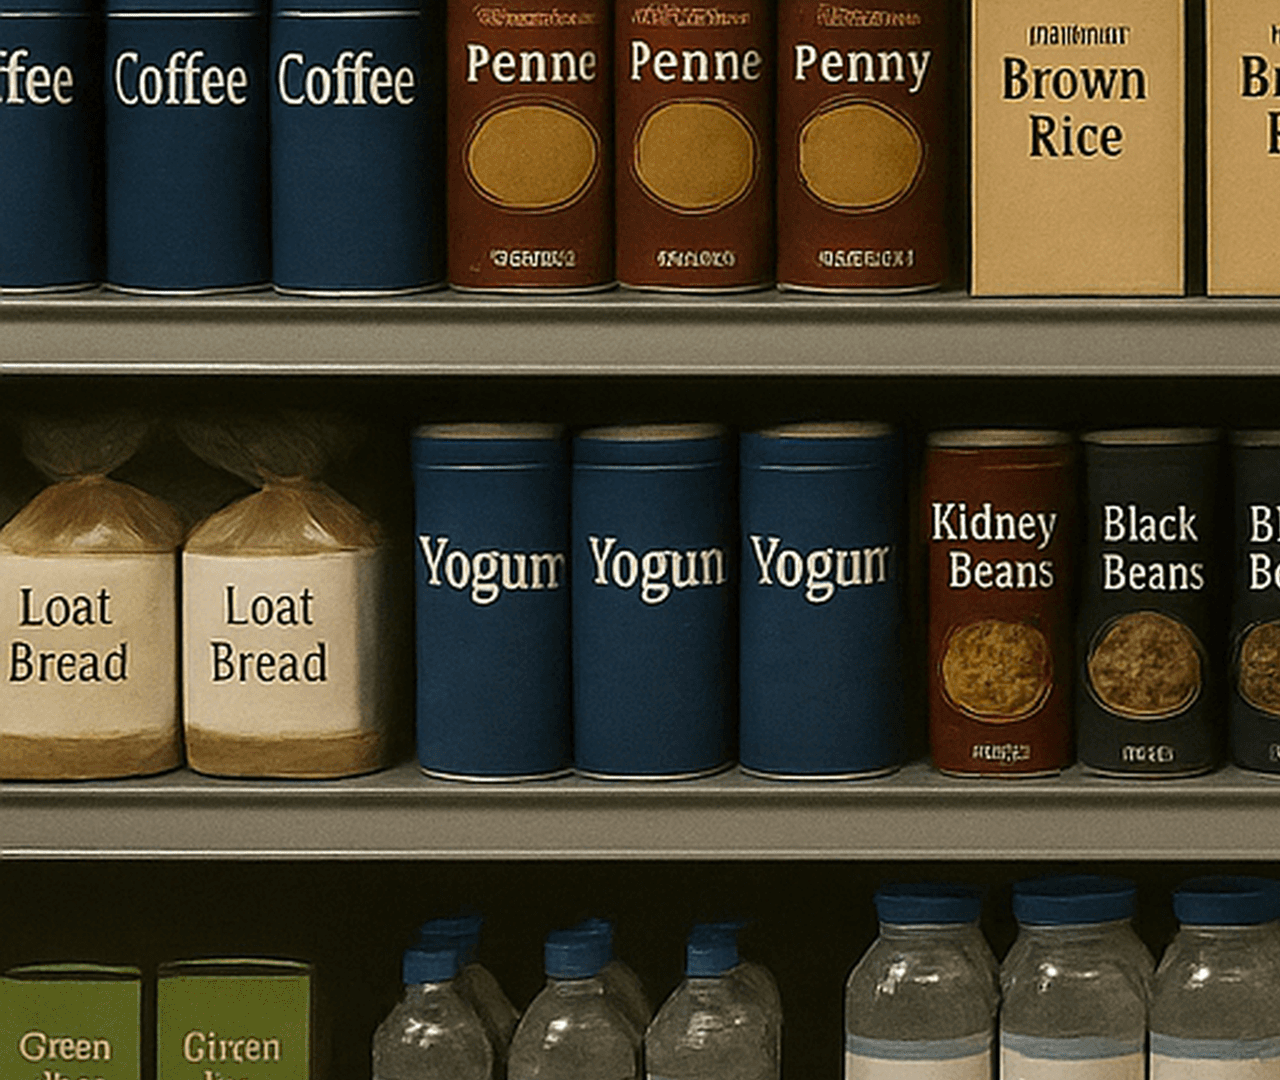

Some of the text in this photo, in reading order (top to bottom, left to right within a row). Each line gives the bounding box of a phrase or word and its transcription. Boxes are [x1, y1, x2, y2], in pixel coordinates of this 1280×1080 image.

[115, 50, 248, 106] Coffee
[278, 50, 415, 106] Coffee
[467, 43, 596, 83] Penne
[631, 40, 763, 82] Penne
[794, 44, 931, 93] Penny
[1003, 56, 1147, 100] Brown
[1029, 114, 1124, 157] Rice
[932, 503, 1057, 549] Kidney
[1104, 505, 1198, 541] Black
[950, 552, 1053, 588] Beans
[1103, 553, 1204, 590] Beans
[20, 588, 113, 626] Loat
[225, 585, 314, 625] Loat
[9, 641, 128, 682] Bread
[211, 641, 327, 682] Bread
[19, 1031, 111, 1061] Green
